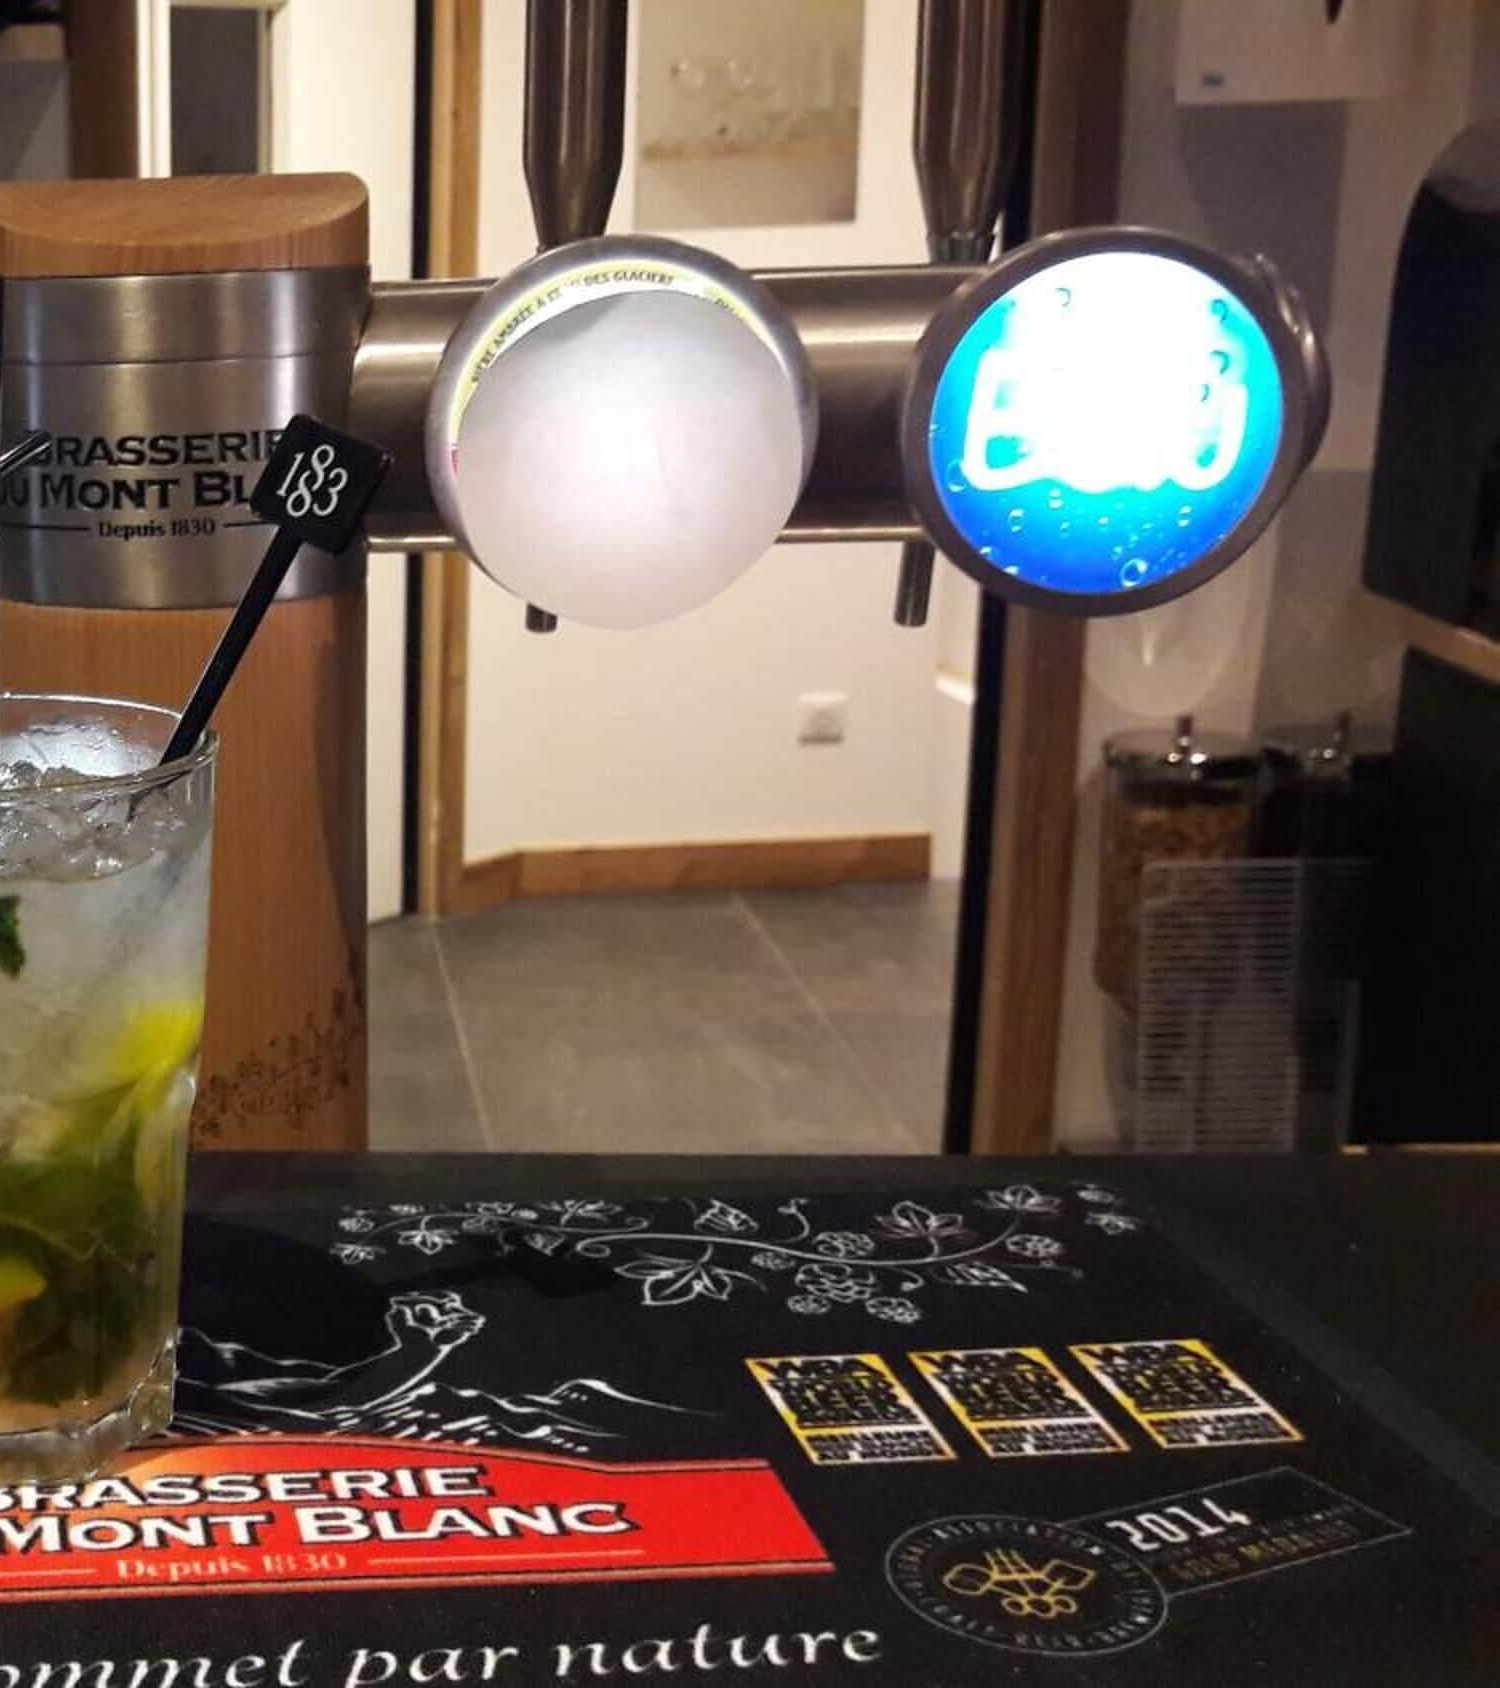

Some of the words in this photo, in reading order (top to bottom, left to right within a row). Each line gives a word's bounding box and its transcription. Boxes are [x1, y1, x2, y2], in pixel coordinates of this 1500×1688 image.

[41, 473, 179, 511] MONT
[98, 520, 164, 541] Depuis
[171, 519, 216, 537] 1830
[297, 1500, 641, 1547] BLANC
[1104, 1498, 1251, 1551] 2014
[116, 1553, 250, 1582] Depuis
[262, 1550, 348, 1575] 1830
[345, 1644, 518, 1687] par
[553, 1622, 881, 1681] nature
